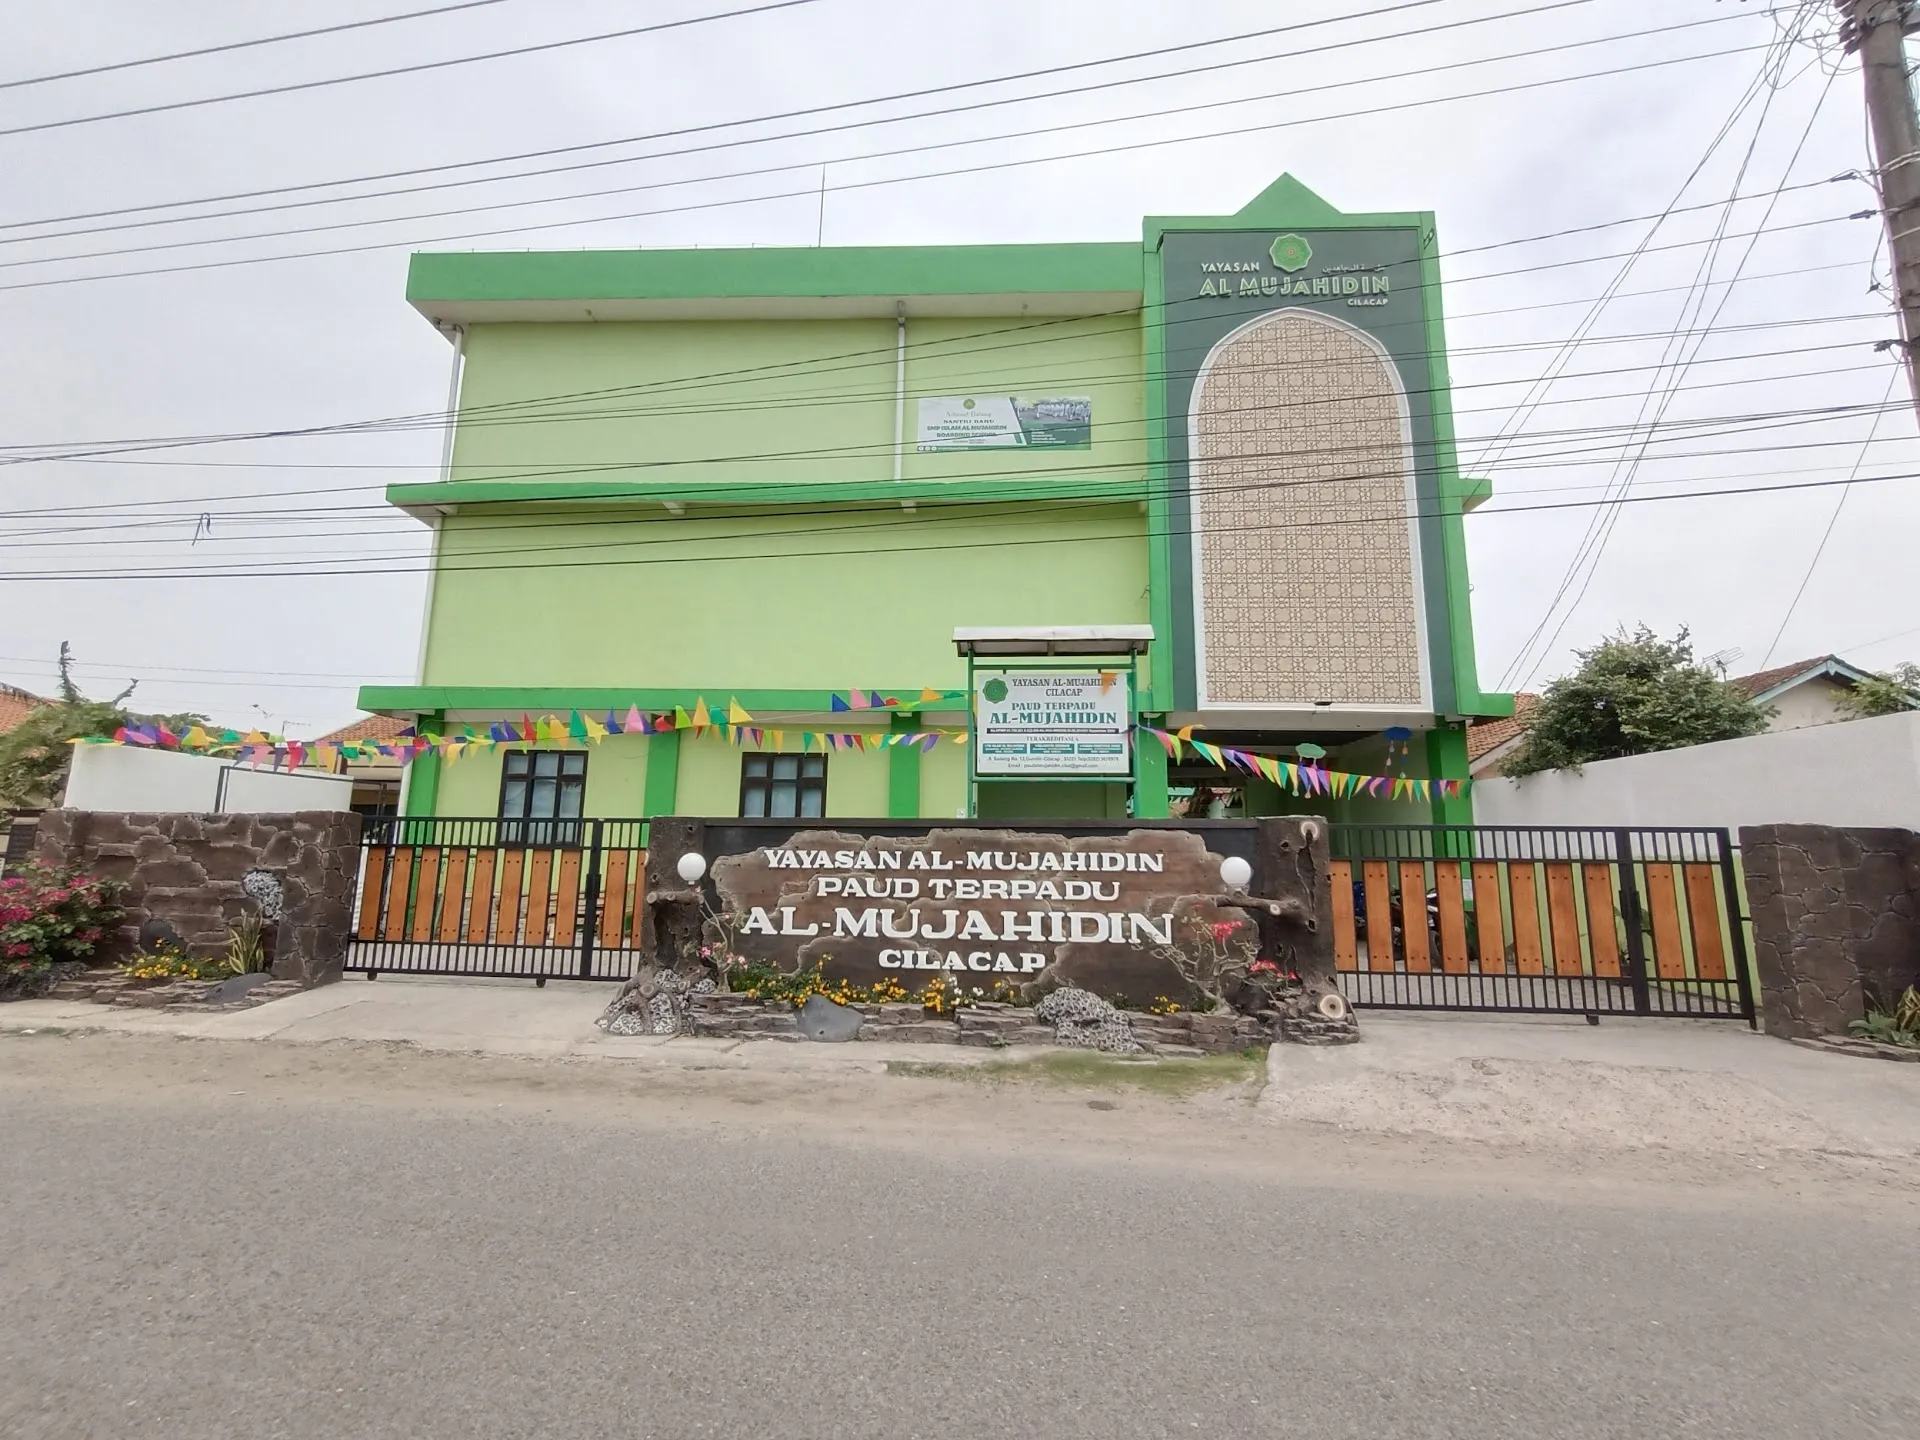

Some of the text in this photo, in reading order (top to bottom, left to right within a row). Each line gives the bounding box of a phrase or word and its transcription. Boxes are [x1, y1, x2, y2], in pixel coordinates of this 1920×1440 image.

[1200, 262, 1260, 273] YAYASAN
[1199, 275, 1390, 297] AL MUJAHIDIN
[1347, 298, 1389, 307] CILACAP
[1012, 678, 1117, 687] YAYASAN AL-MUJAHIN
[1045, 688, 1083, 697] CILACAP
[1011, 701, 1096, 711] PAUD TERPADU
[989, 711, 1117, 725] AL-MUJAHIDIN
[764, 849, 1164, 873] YAYASAN AL-MUJAHIDIN
[816, 876, 1121, 901] PAUD TERPADU
[739, 905, 1175, 946] AL-MUJAHIDIN
[877, 948, 1046, 974] CILACAP
